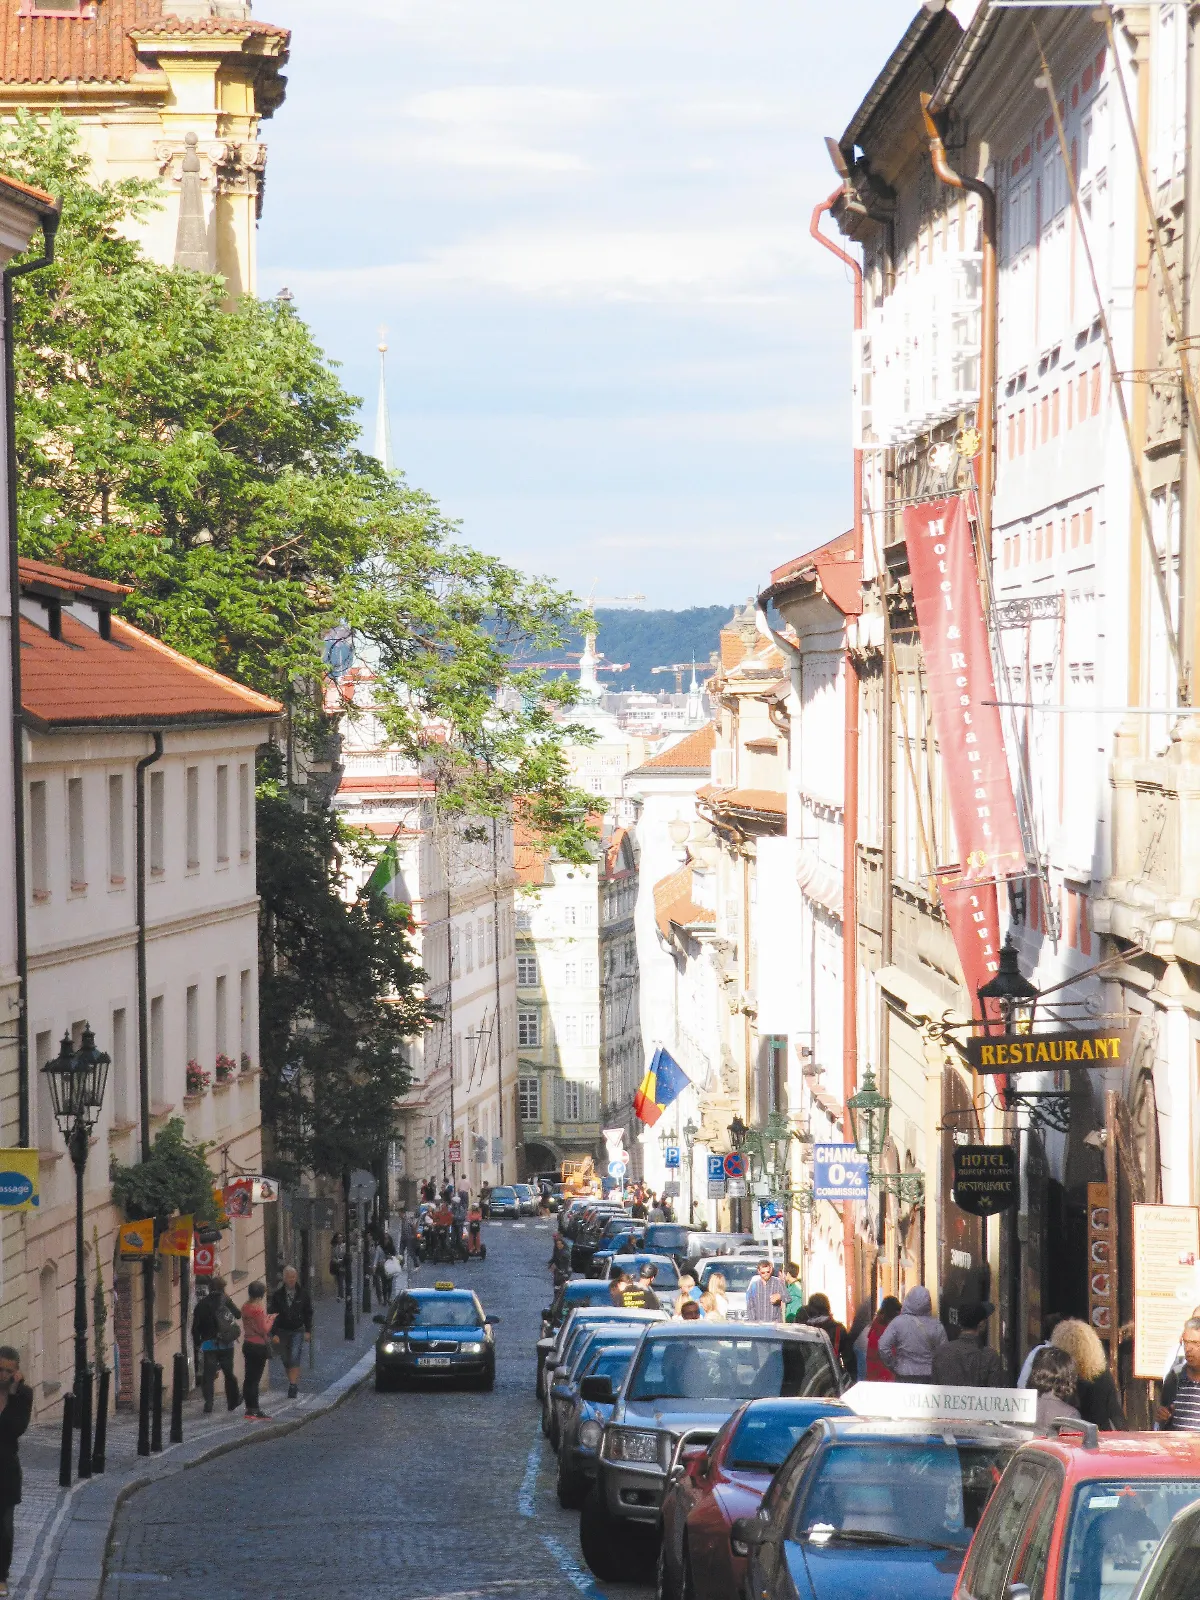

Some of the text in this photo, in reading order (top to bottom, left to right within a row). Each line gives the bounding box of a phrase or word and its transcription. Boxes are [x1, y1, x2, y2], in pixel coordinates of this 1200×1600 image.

[927, 518, 992, 836] Hotel & Restaurant
[980, 1037, 1121, 1066] RESTAURANT
[816, 1145, 868, 1164] CHANGE
[961, 1154, 1008, 1167] HOTEL
[828, 1163, 863, 1186] 0%
[816, 1186, 867, 1197] COMMISSION
[944, 1394, 1030, 1413] RESTAURANT
